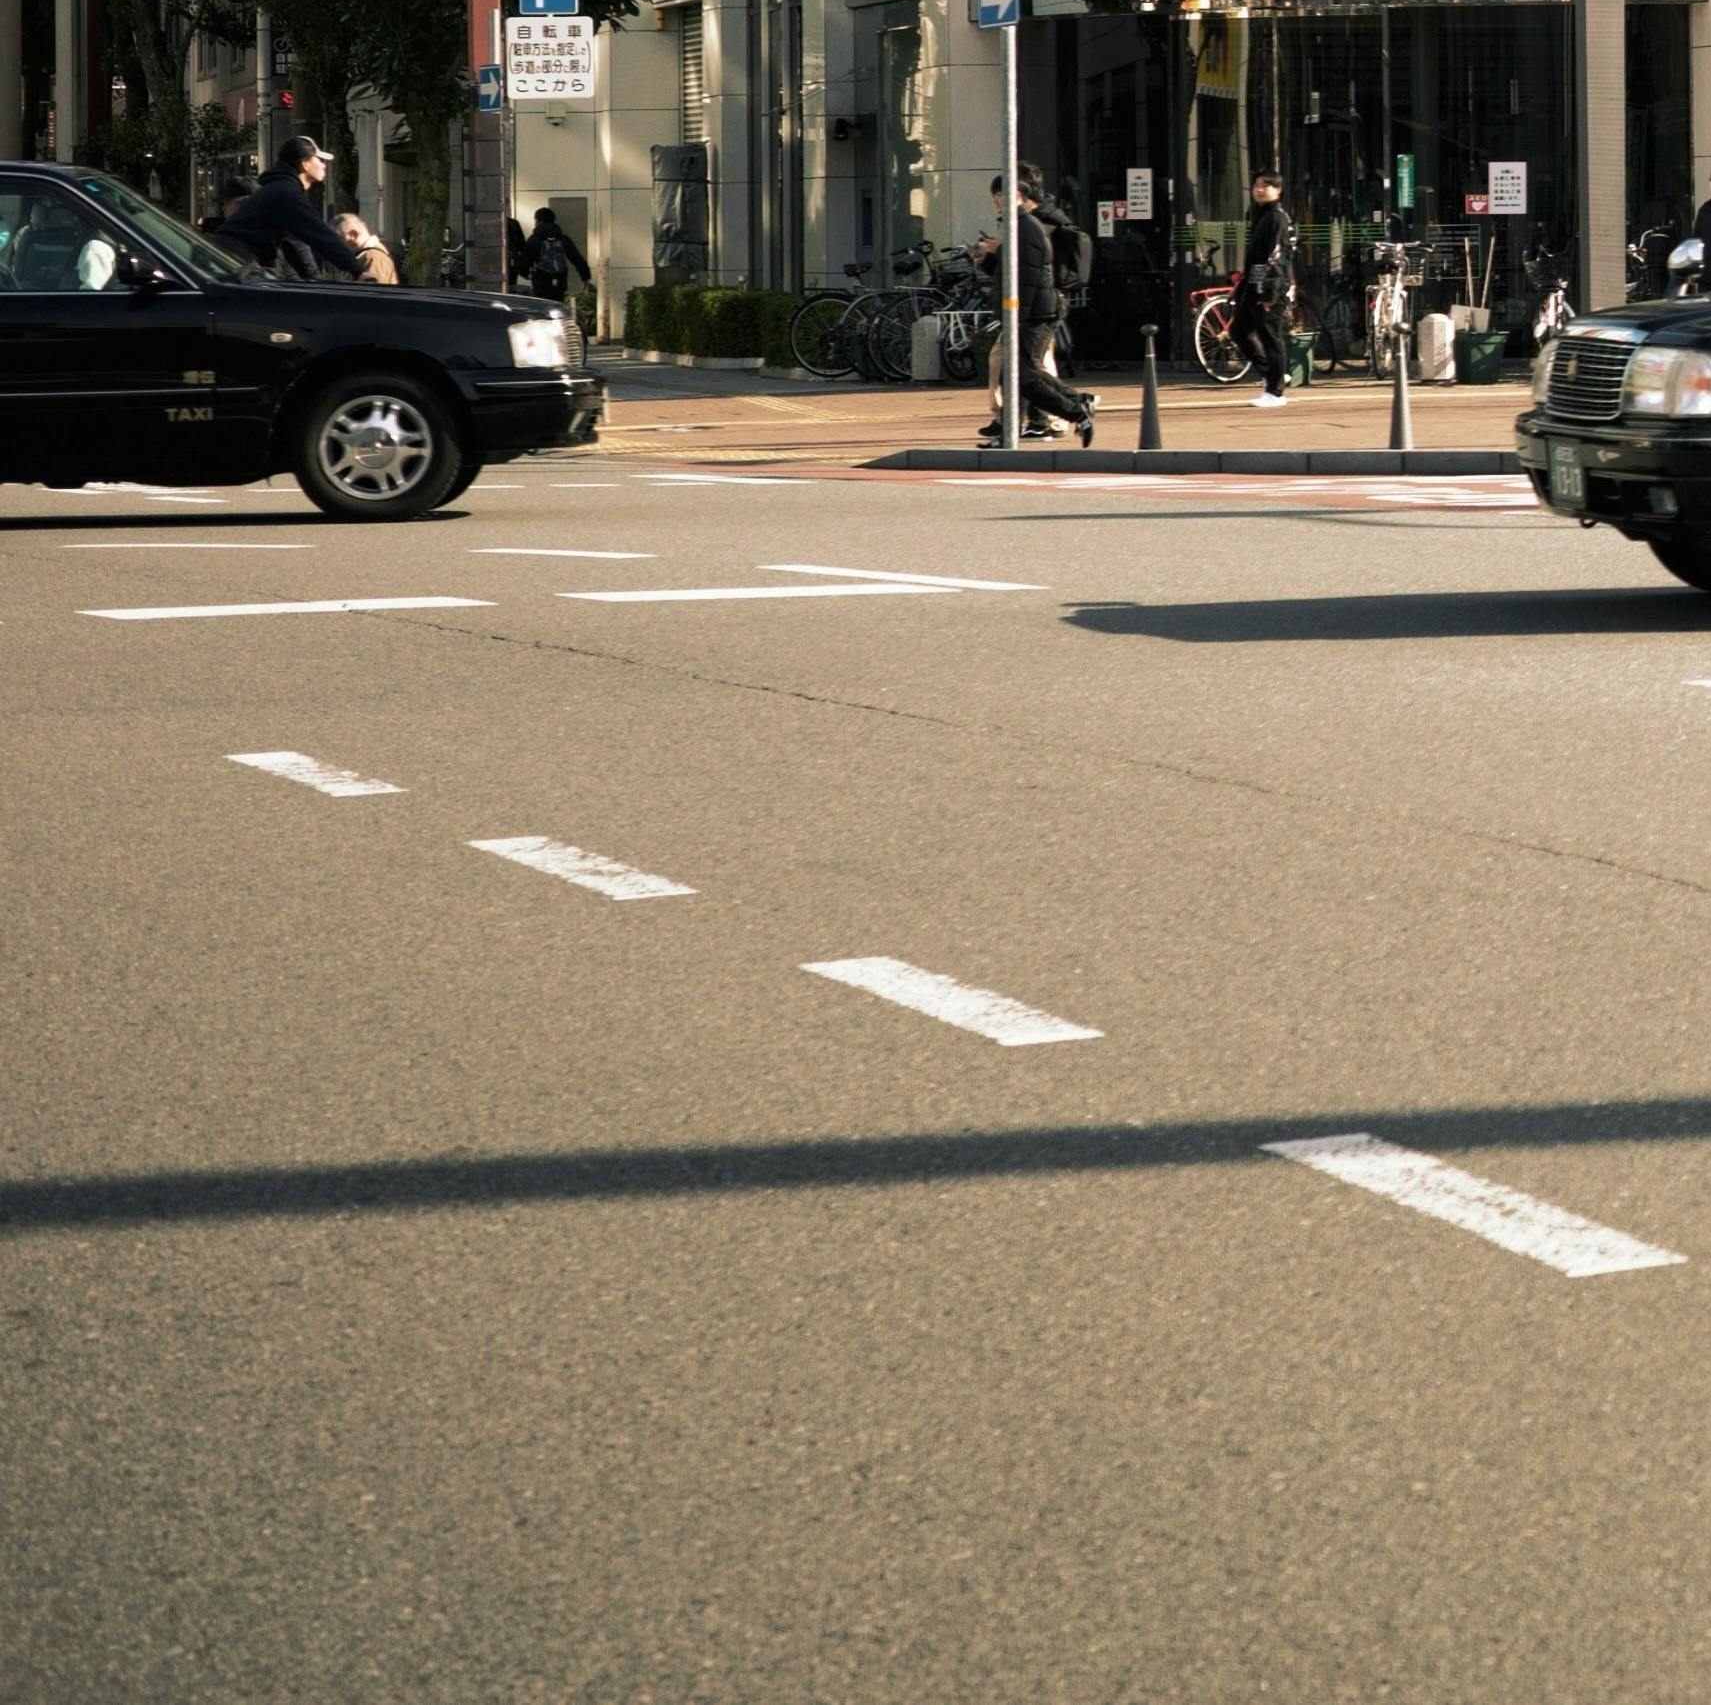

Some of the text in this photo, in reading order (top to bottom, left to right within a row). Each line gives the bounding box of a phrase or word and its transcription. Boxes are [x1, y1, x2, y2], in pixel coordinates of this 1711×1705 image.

[516, 25, 583, 40] 自転車
[515, 78, 586, 93] ここから
[163, 406, 214, 422] TAXI
